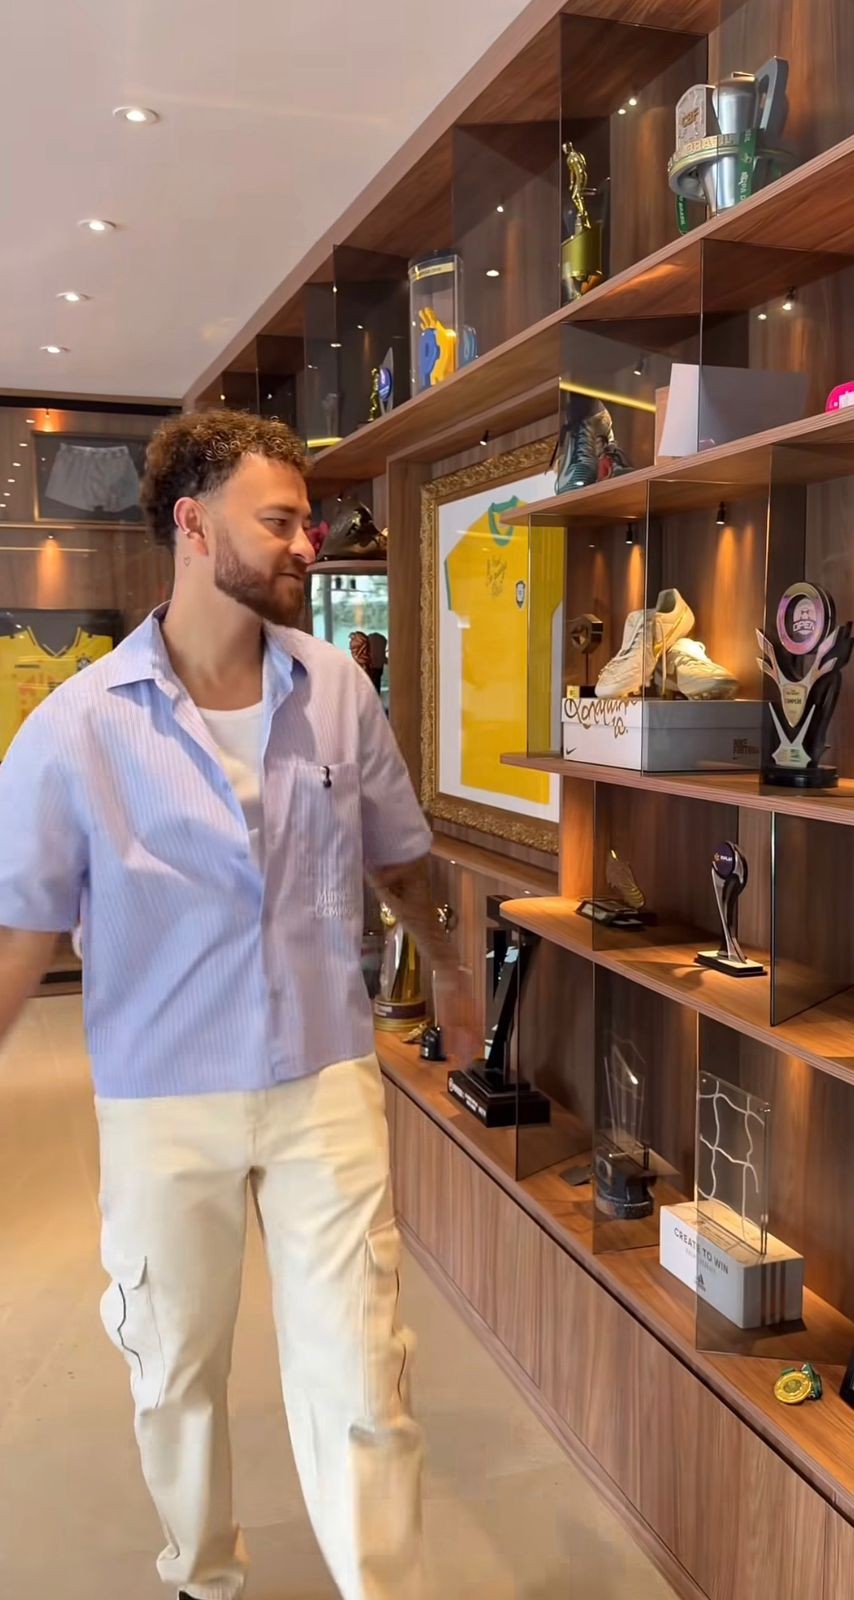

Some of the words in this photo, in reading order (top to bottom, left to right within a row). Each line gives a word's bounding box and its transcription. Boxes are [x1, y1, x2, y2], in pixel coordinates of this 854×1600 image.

[674, 1227, 701, 1254] CREATE
[702, 1247, 712, 1262] TO
[715, 1258, 729, 1274] WIN
